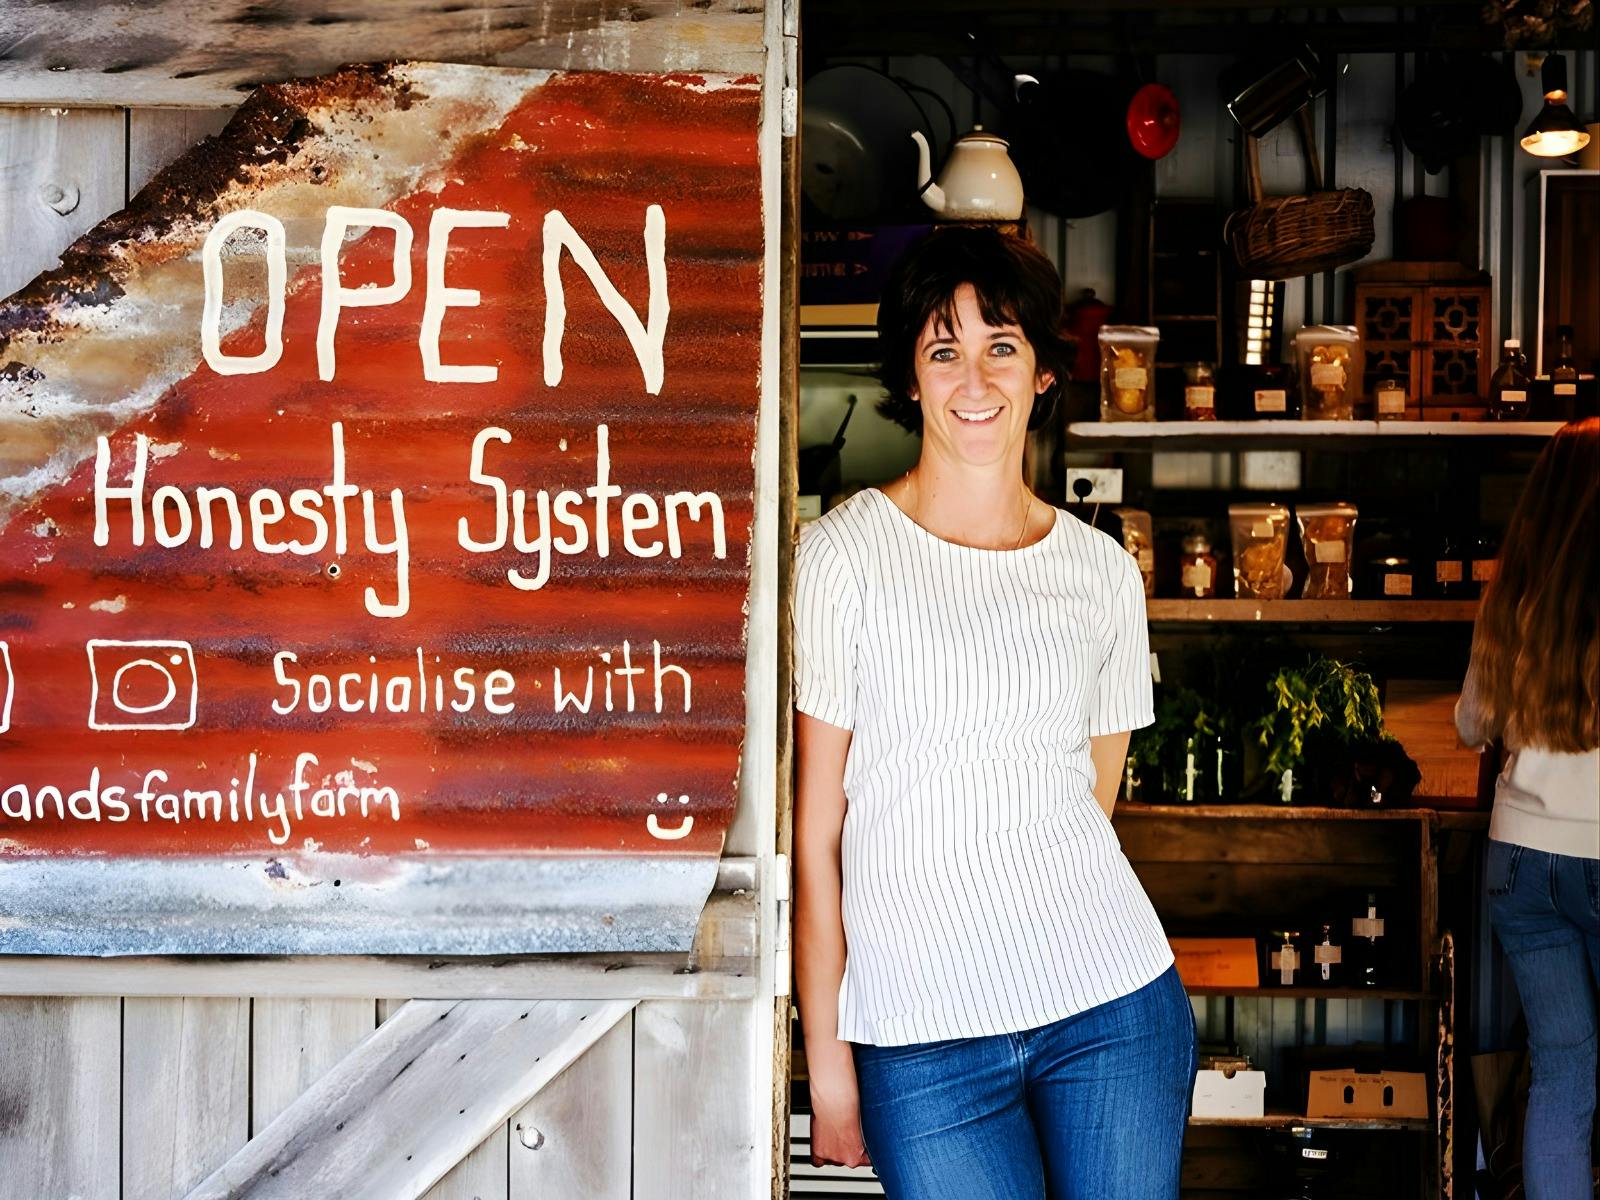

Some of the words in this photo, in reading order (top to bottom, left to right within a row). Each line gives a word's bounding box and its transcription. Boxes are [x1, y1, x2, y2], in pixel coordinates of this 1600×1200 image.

[203, 205, 670, 395] OPEN
[94, 422, 409, 617] Honesty
[458, 424, 727, 591] System
[271, 646, 515, 715] Socialise
[554, 639, 692, 714] with
